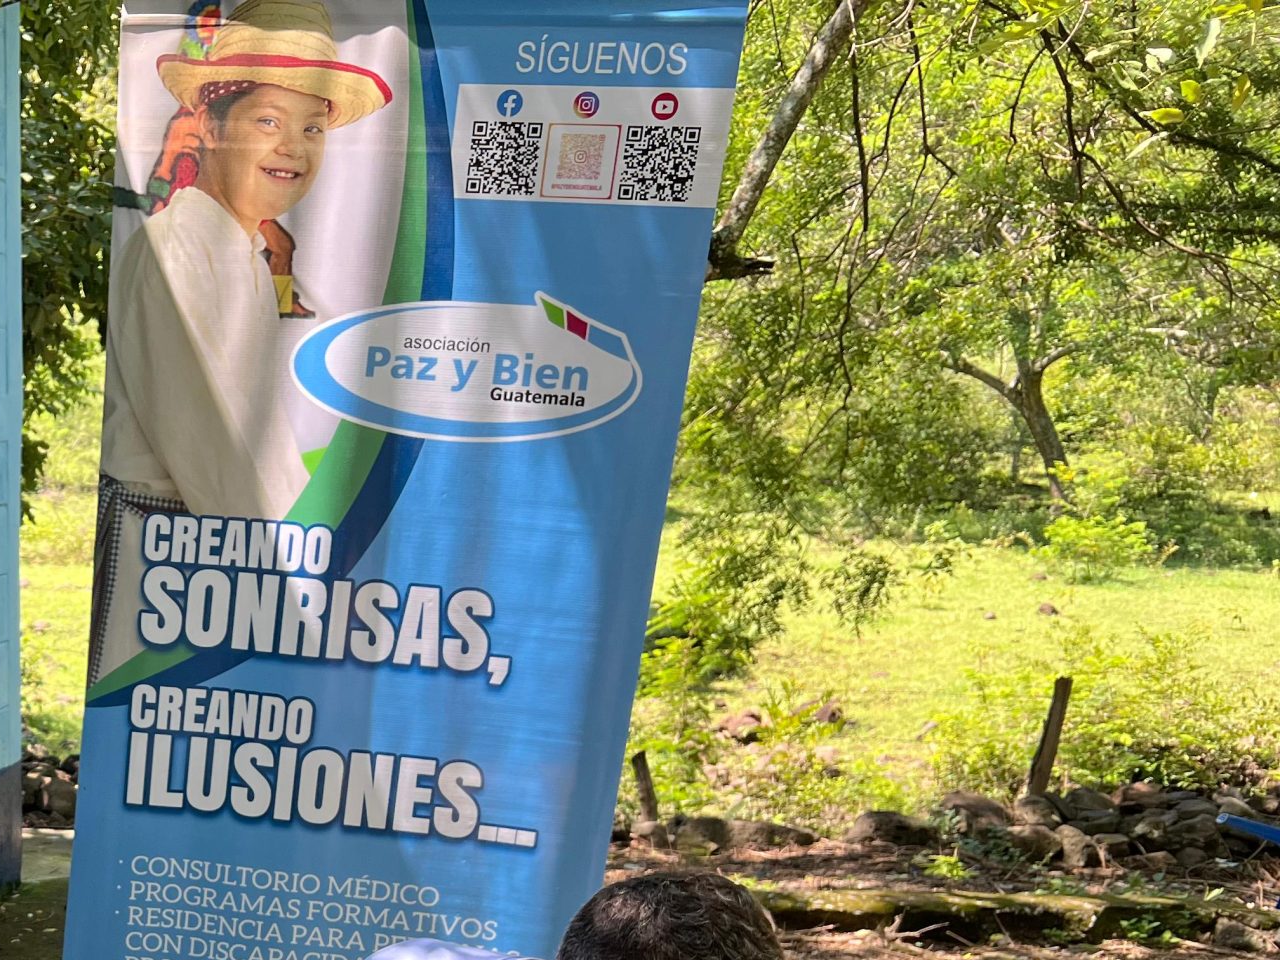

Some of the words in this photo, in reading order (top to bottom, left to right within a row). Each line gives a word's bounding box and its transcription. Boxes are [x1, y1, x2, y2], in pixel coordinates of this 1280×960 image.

[515, 34, 688, 75] SÍGUENOS
[364, 346, 436, 380] Paz
[450, 358, 478, 392] y
[492, 353, 589, 391] Bien
[403, 336, 490, 354] asociación
[489, 387, 586, 407] Guatemala
[144, 514, 332, 575] CREANDO
[140, 566, 511, 685] SONRISAS,
[130, 684, 313, 744] CREANDO
[125, 732, 537, 848] ILUSIONES...
[131, 855, 320, 894] CONSULTORIO
[327, 874, 440, 907] MÉDICO
[127, 906, 283, 943] RESIDENCIA
[292, 925, 365, 951] PARA
[129, 881, 300, 919] PROGRAMAS
[307, 901, 498, 941] FORMATIVOS
[125, 931, 182, 957] CON
